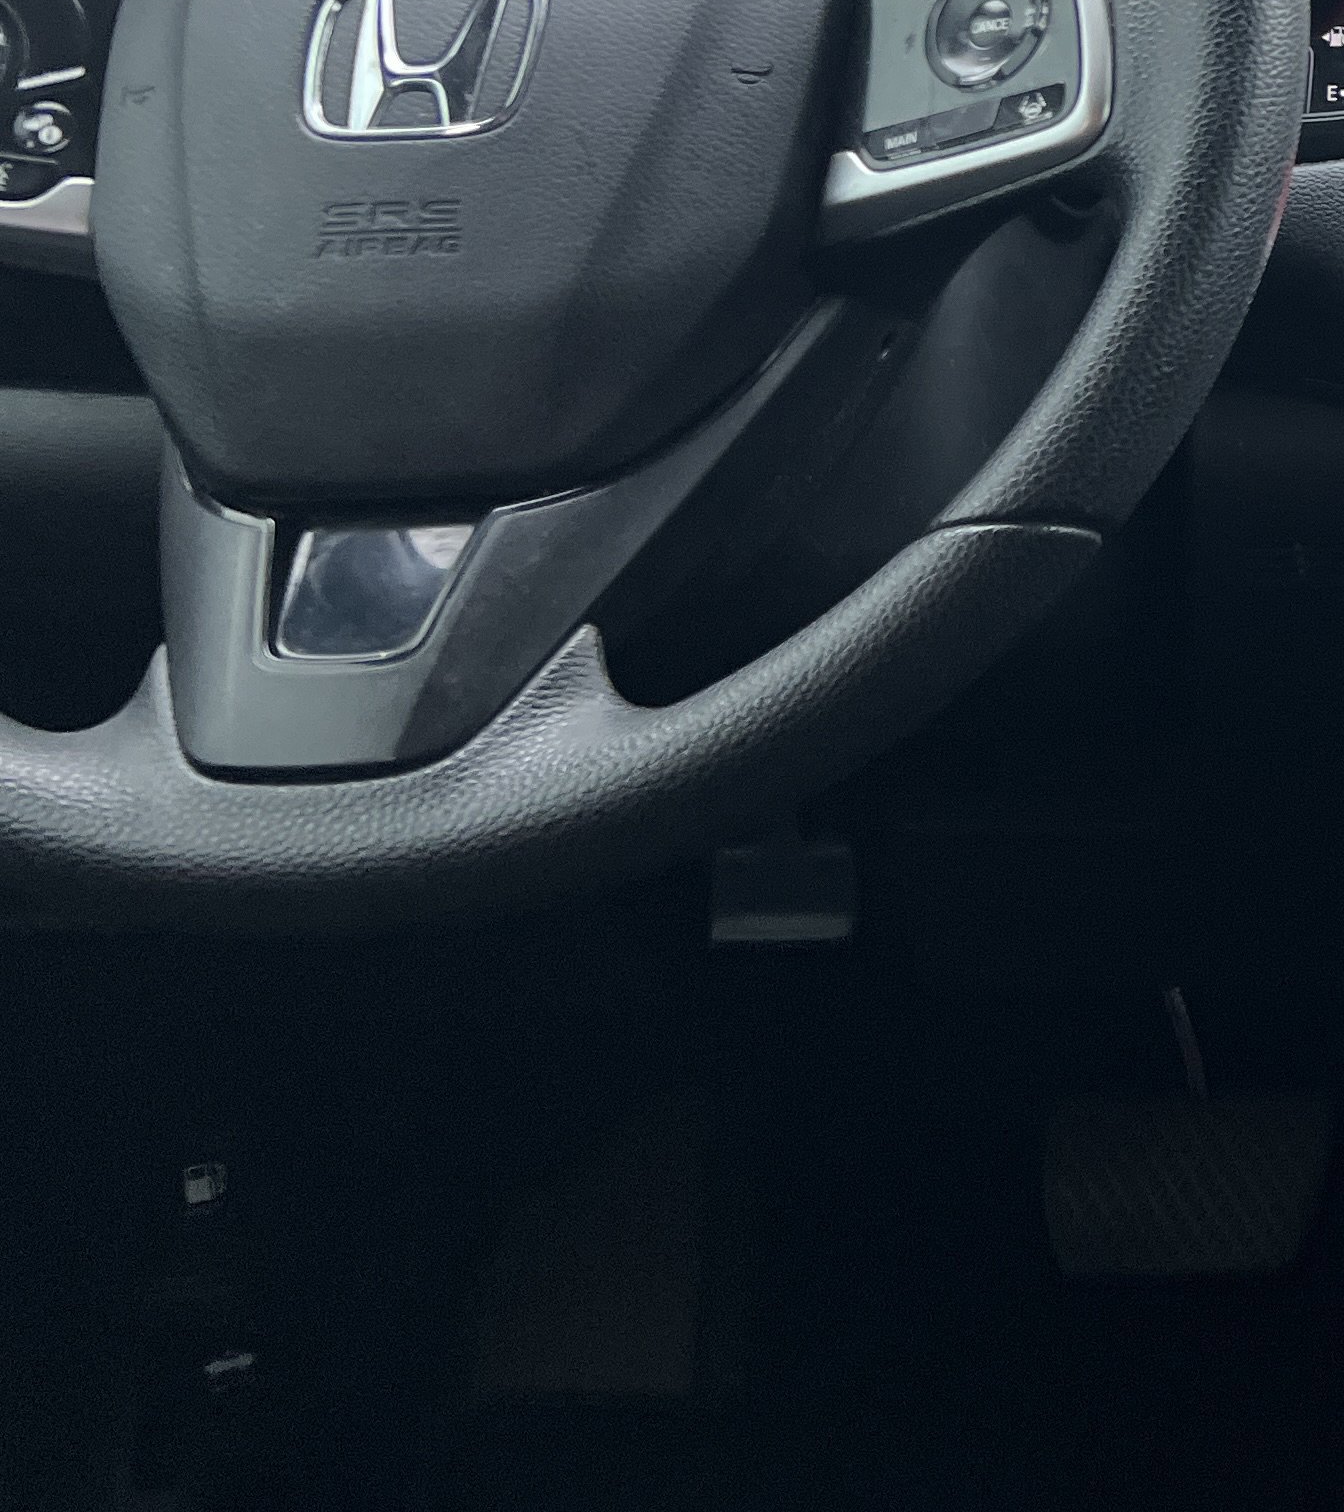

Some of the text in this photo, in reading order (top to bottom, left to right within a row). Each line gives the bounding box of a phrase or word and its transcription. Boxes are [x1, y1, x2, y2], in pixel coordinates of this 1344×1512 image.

[1326, 84, 1338, 102] E
[884, 130, 918, 150] MAIN
[321, 199, 463, 230] SRS
